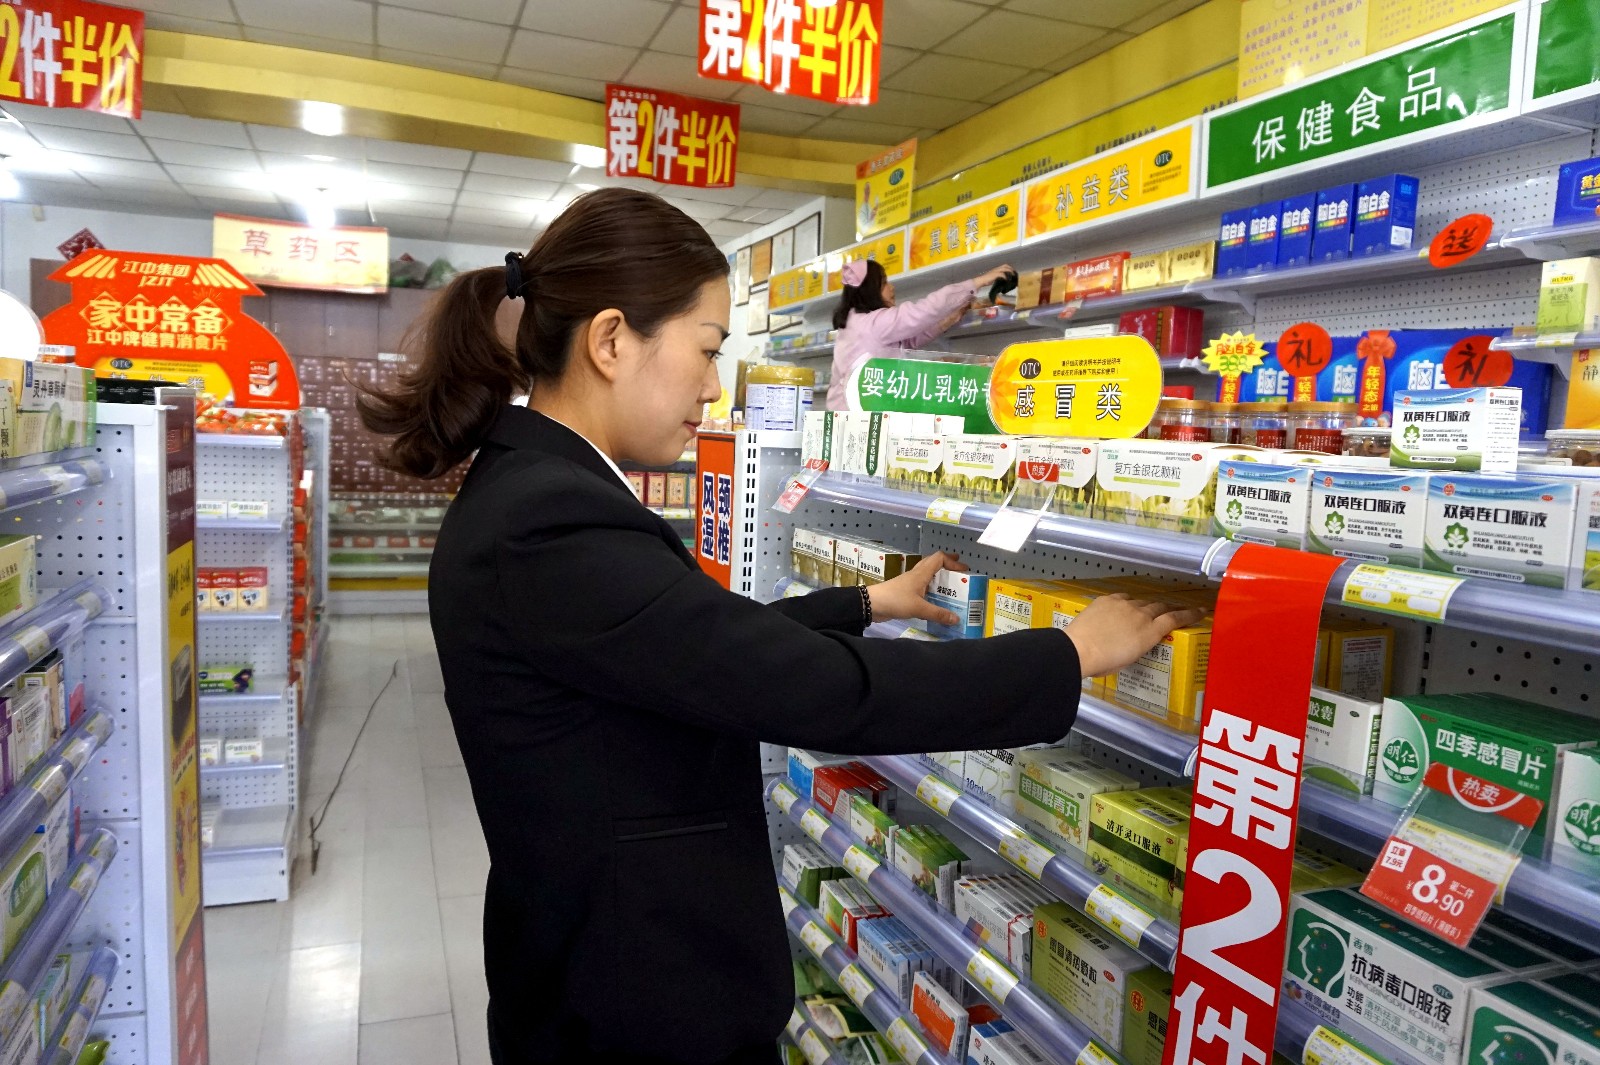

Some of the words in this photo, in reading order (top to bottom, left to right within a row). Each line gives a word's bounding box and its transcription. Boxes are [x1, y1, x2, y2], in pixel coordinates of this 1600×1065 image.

[702, 0, 878, 98] 第2件半价
[1252, 66, 1442, 163] 保健食品
[608, 98, 736, 184] 第2件半价
[1154, 150, 1173, 167] OTC
[1055, 163, 1130, 221] 补益类
[240, 229, 363, 265] 草药区
[928, 213, 979, 256] 其他类
[121, 260, 192, 278] 江中集团
[88, 298, 225, 336] 家中常备
[86, 329, 229, 352] 江中牌健胃消食片
[1286, 331, 1324, 368] 礼
[111, 359, 132, 369] OTC
[1020, 360, 1040, 378] OTC
[1454, 344, 1497, 386] 礼
[1013, 382, 1123, 421] 感冒类
[1364, 365, 1381, 403] 年轻态
[1403, 410, 1472, 423] 双黄连口服液
[1113, 461, 1182, 481] 复方金银花颗粒
[1226, 483, 1292, 504] 双黄连口服液
[1324, 494, 1406, 515] 双黄连口服液
[1443, 503, 1549, 528] 双黄连口服液
[1149, 645, 1170, 662] 颗粒
[1385, 740, 1419, 764] 明仁
[1436, 728, 1548, 781] 四季感冒片
[1461, 777, 1501, 806] 热卖
[1106, 818, 1162, 856] 清开灵口服液
[1173, 708, 1302, 1065] 第2件
[1049, 936, 1097, 985] 感冒清热颗粒
[1345, 998, 1363, 1015] 主治
[1347, 985, 1365, 1004] 功能
[1351, 953, 1453, 1026] 抗病毒口服液
